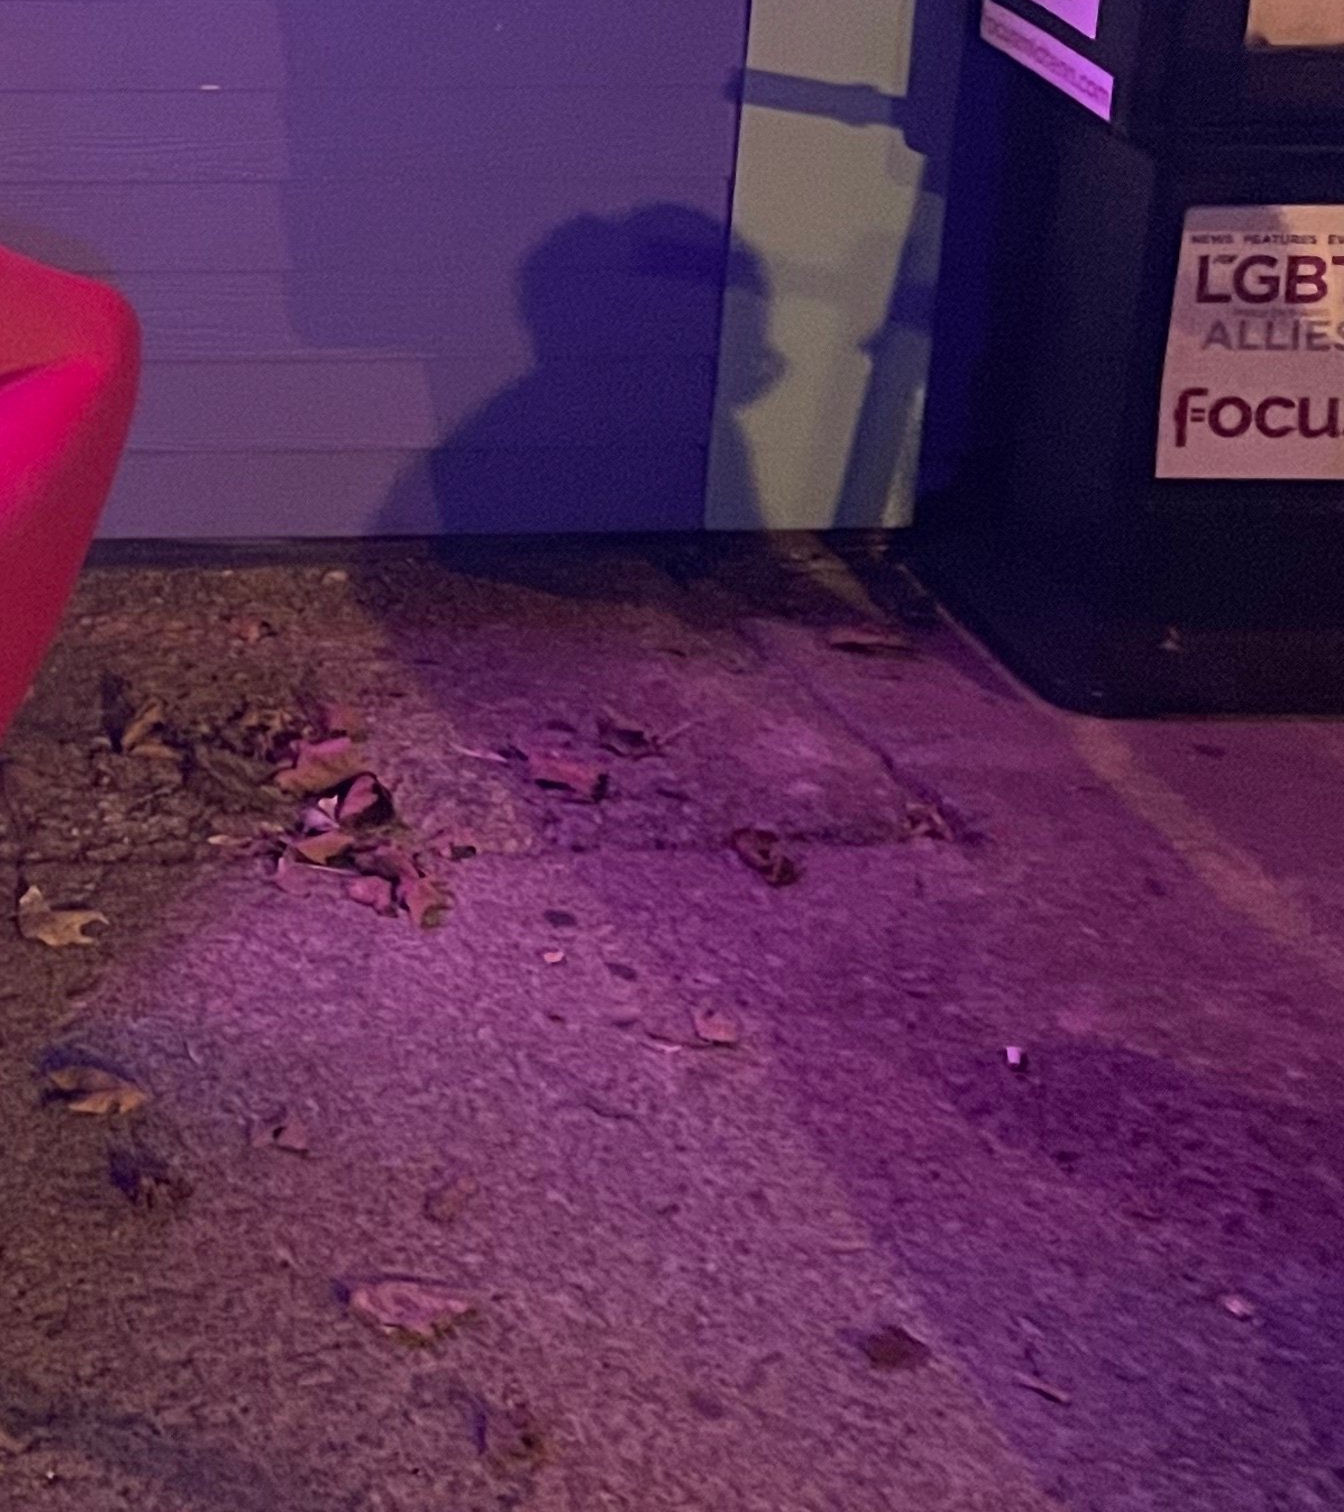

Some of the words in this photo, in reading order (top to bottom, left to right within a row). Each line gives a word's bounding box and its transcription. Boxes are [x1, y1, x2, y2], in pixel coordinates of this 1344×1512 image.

[1191, 234, 1233, 244] NEWS
[1243, 234, 1317, 245] FEATURES
[1174, 387, 1344, 447] focu
